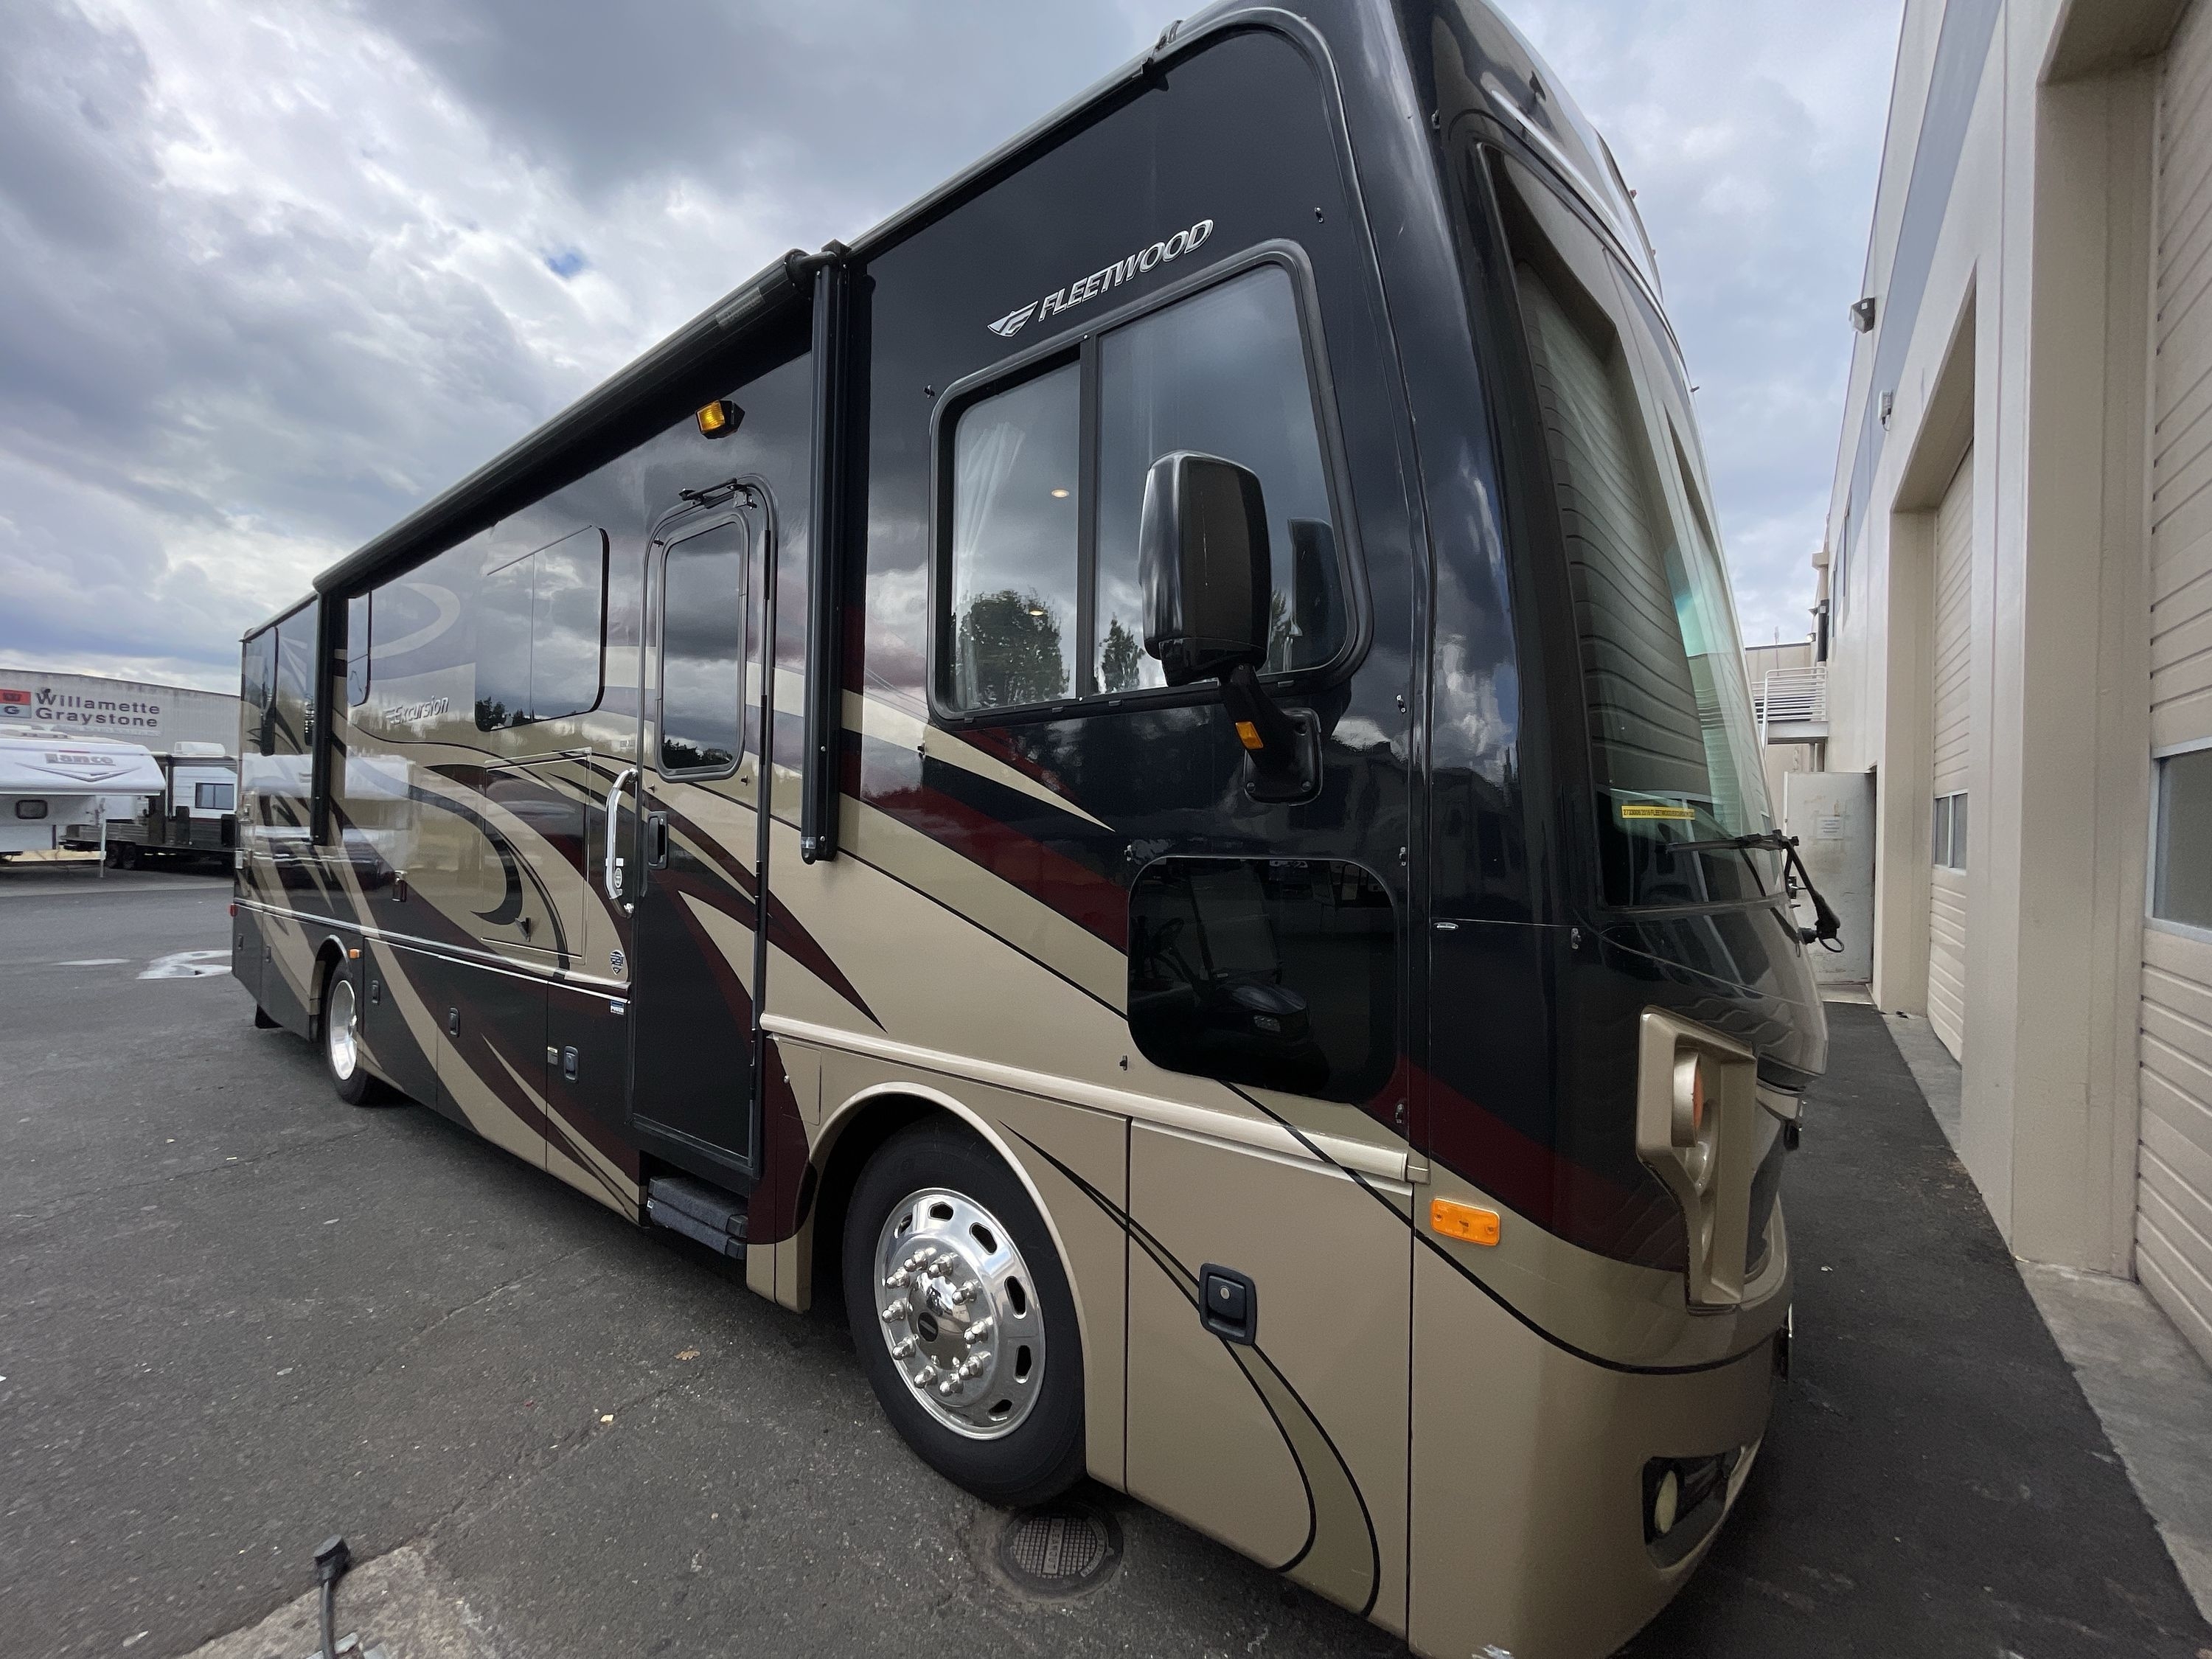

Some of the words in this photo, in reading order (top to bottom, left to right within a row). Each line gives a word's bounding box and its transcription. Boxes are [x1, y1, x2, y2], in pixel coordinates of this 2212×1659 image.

[1038, 219, 1214, 322] FLEETWOOD
[35, 689, 160, 714] Willamette
[389, 695, 449, 725] Excursion
[35, 707, 158, 727] Graystone
